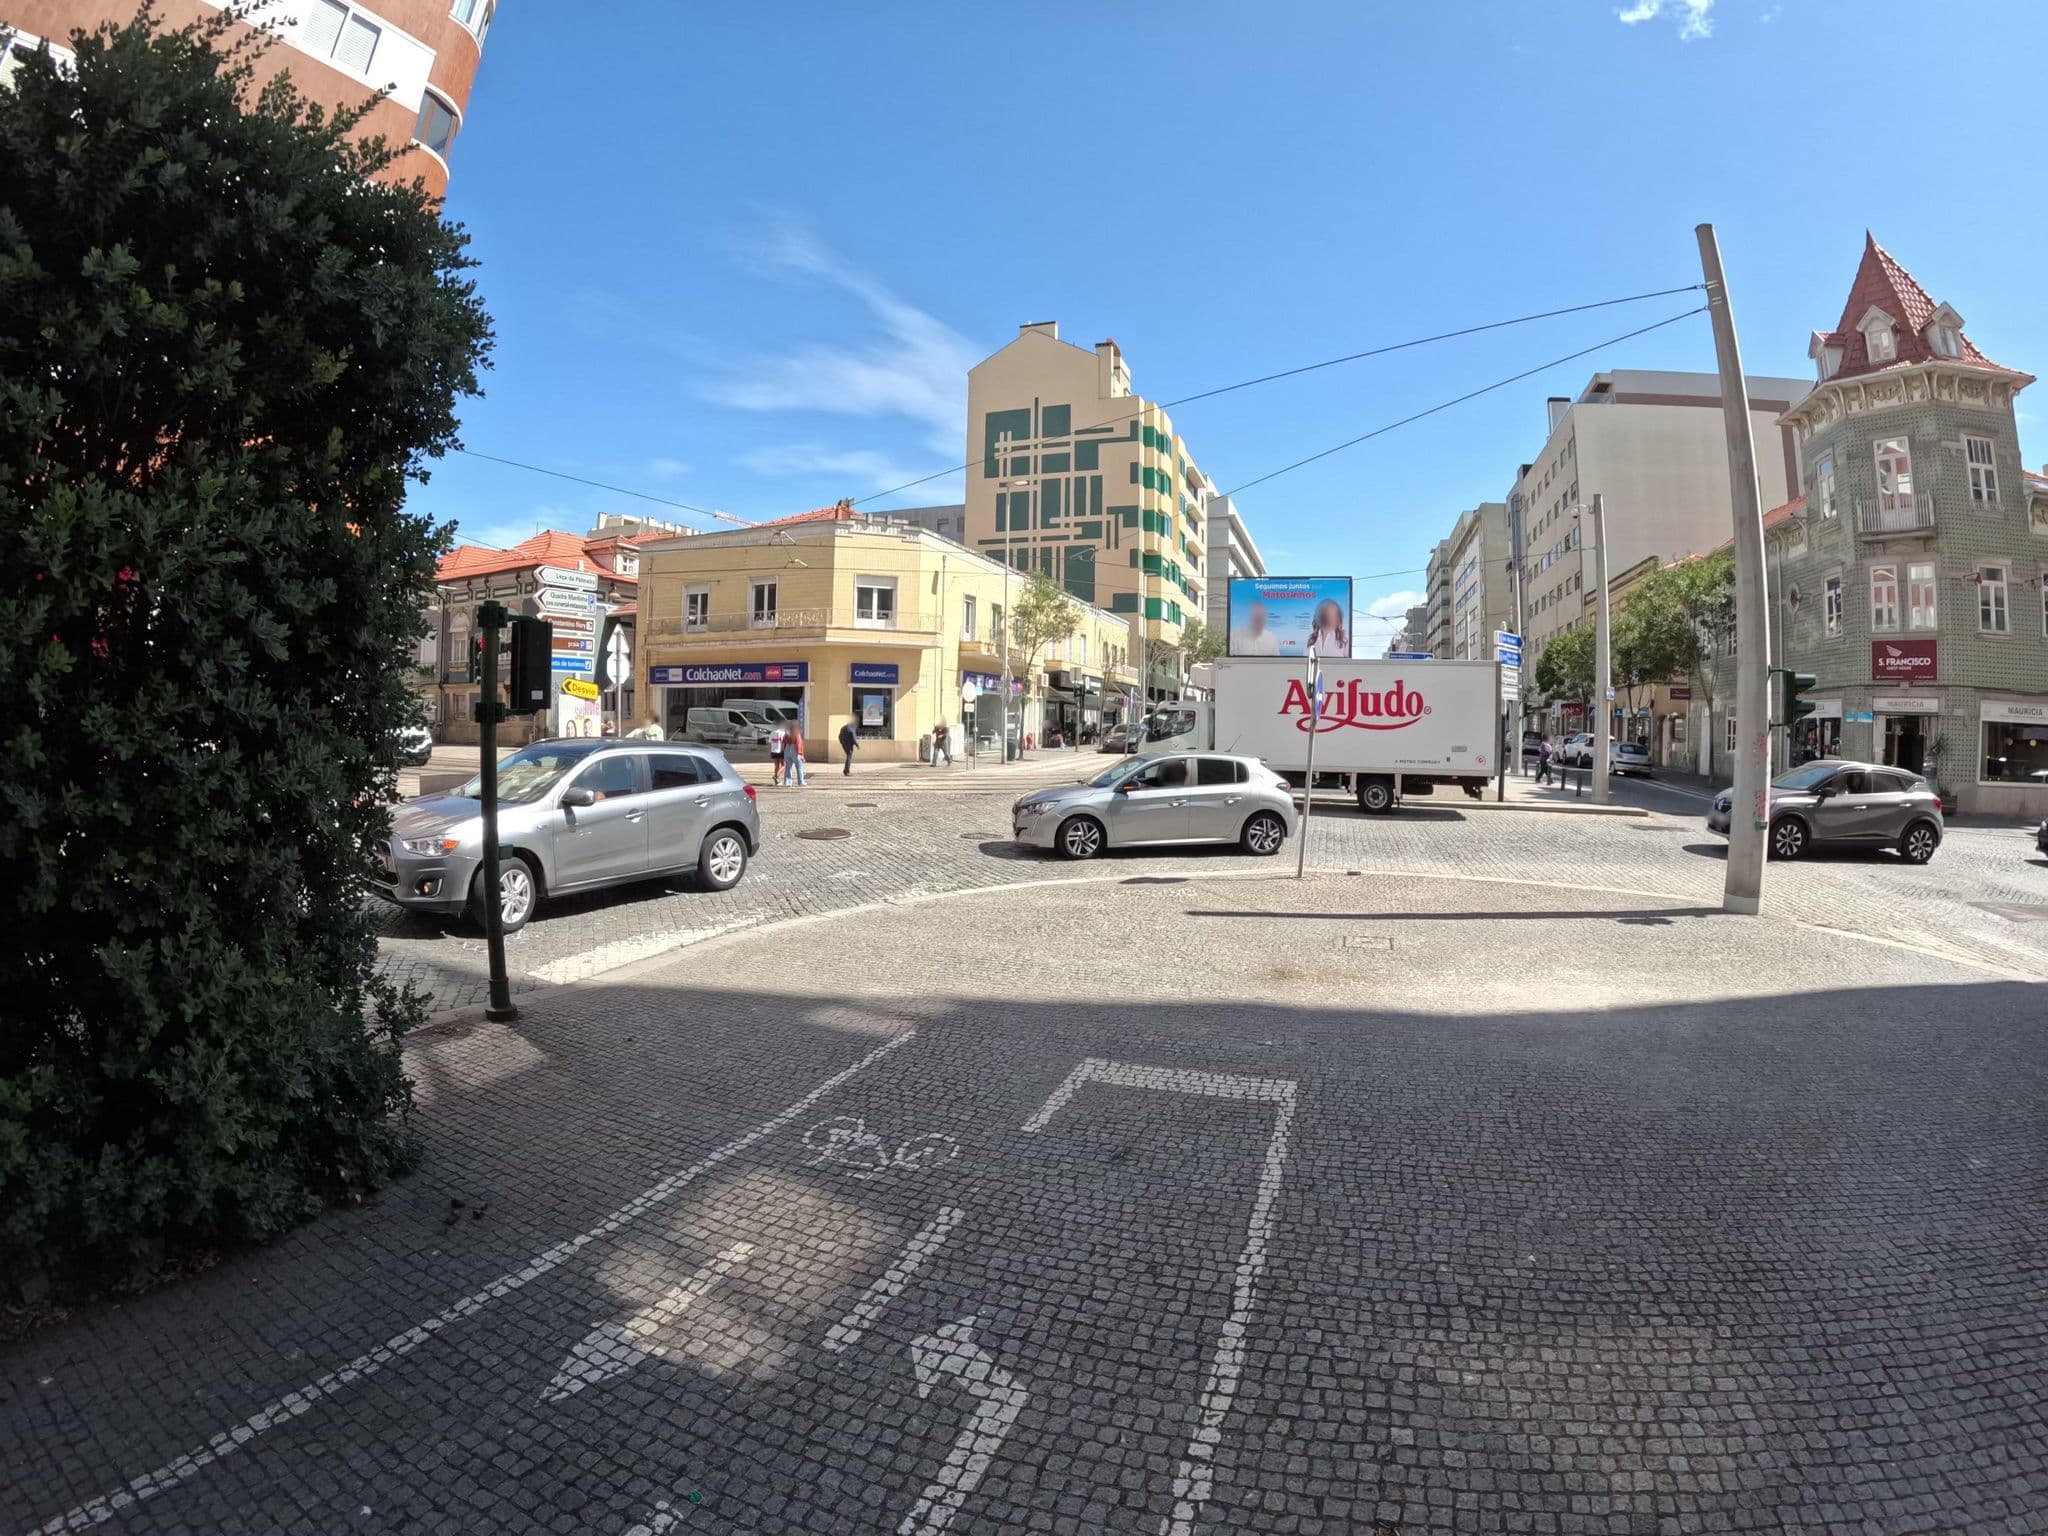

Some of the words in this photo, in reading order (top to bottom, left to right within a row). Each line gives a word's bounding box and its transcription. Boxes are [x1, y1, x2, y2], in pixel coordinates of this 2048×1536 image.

[1255, 582, 1288, 592] Seguimos
[1288, 583, 1310, 592] juntos
[1878, 657, 1885, 666] S.
[1886, 657, 1931, 666] FRANCISCO
[686, 667, 762, 682] ColchaoNet.com
[572, 682, 596, 696] Desvio
